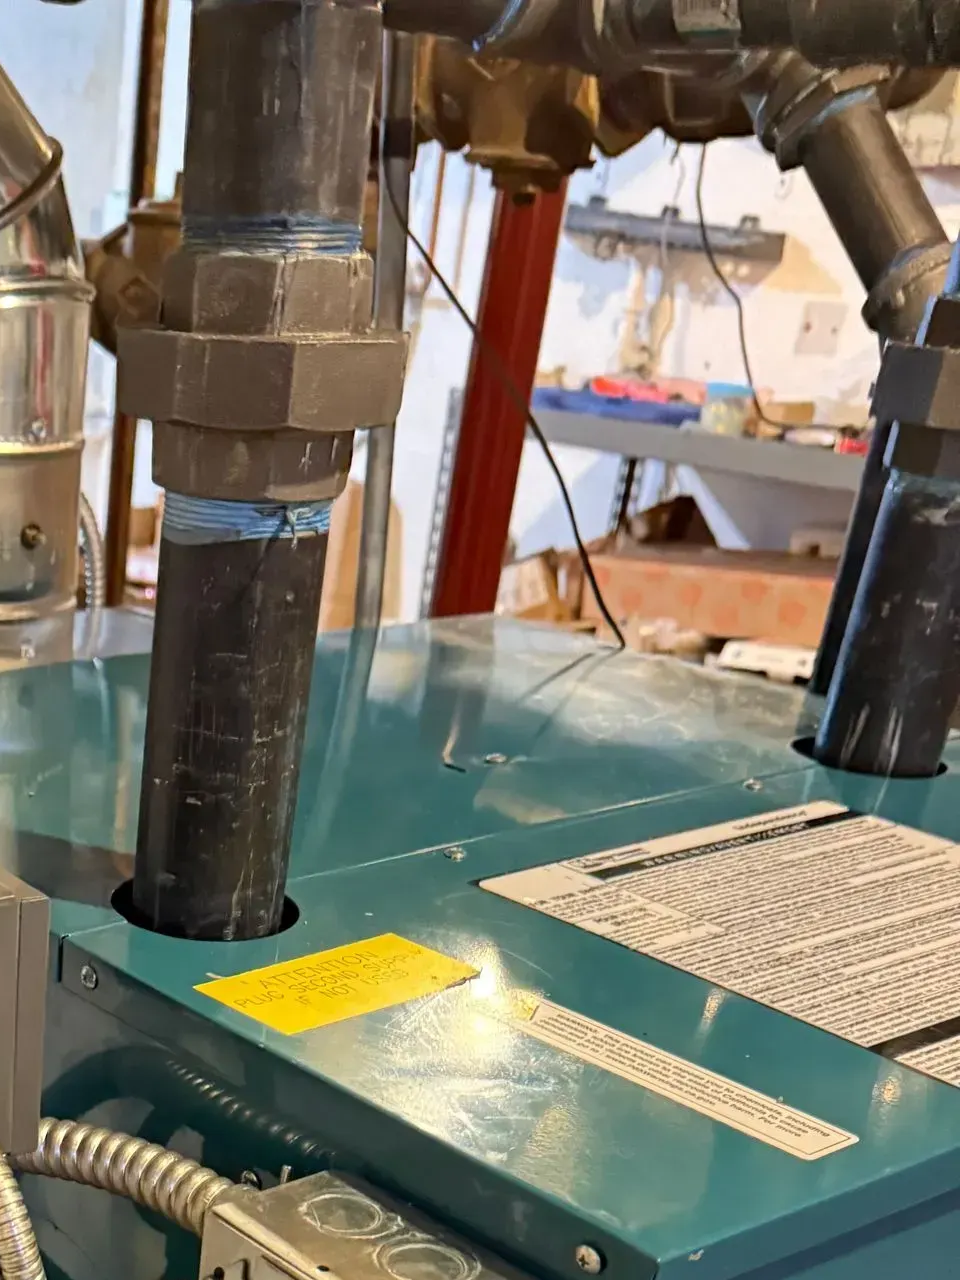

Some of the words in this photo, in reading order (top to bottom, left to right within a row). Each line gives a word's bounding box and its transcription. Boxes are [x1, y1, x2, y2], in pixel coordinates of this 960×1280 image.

[233, 990, 285, 1009] PLUG
[289, 969, 359, 994] SECOND
[259, 951, 378, 990] ATTENTION
[295, 994, 312, 1007] IF
[318, 984, 358, 999] NOT
[722, 1093, 767, 1114] California
[779, 1119, 809, 1133] cause
[735, 1093, 784, 1116] chemicals,
[784, 1115, 831, 1137] including
[775, 1124, 802, 1137] more
